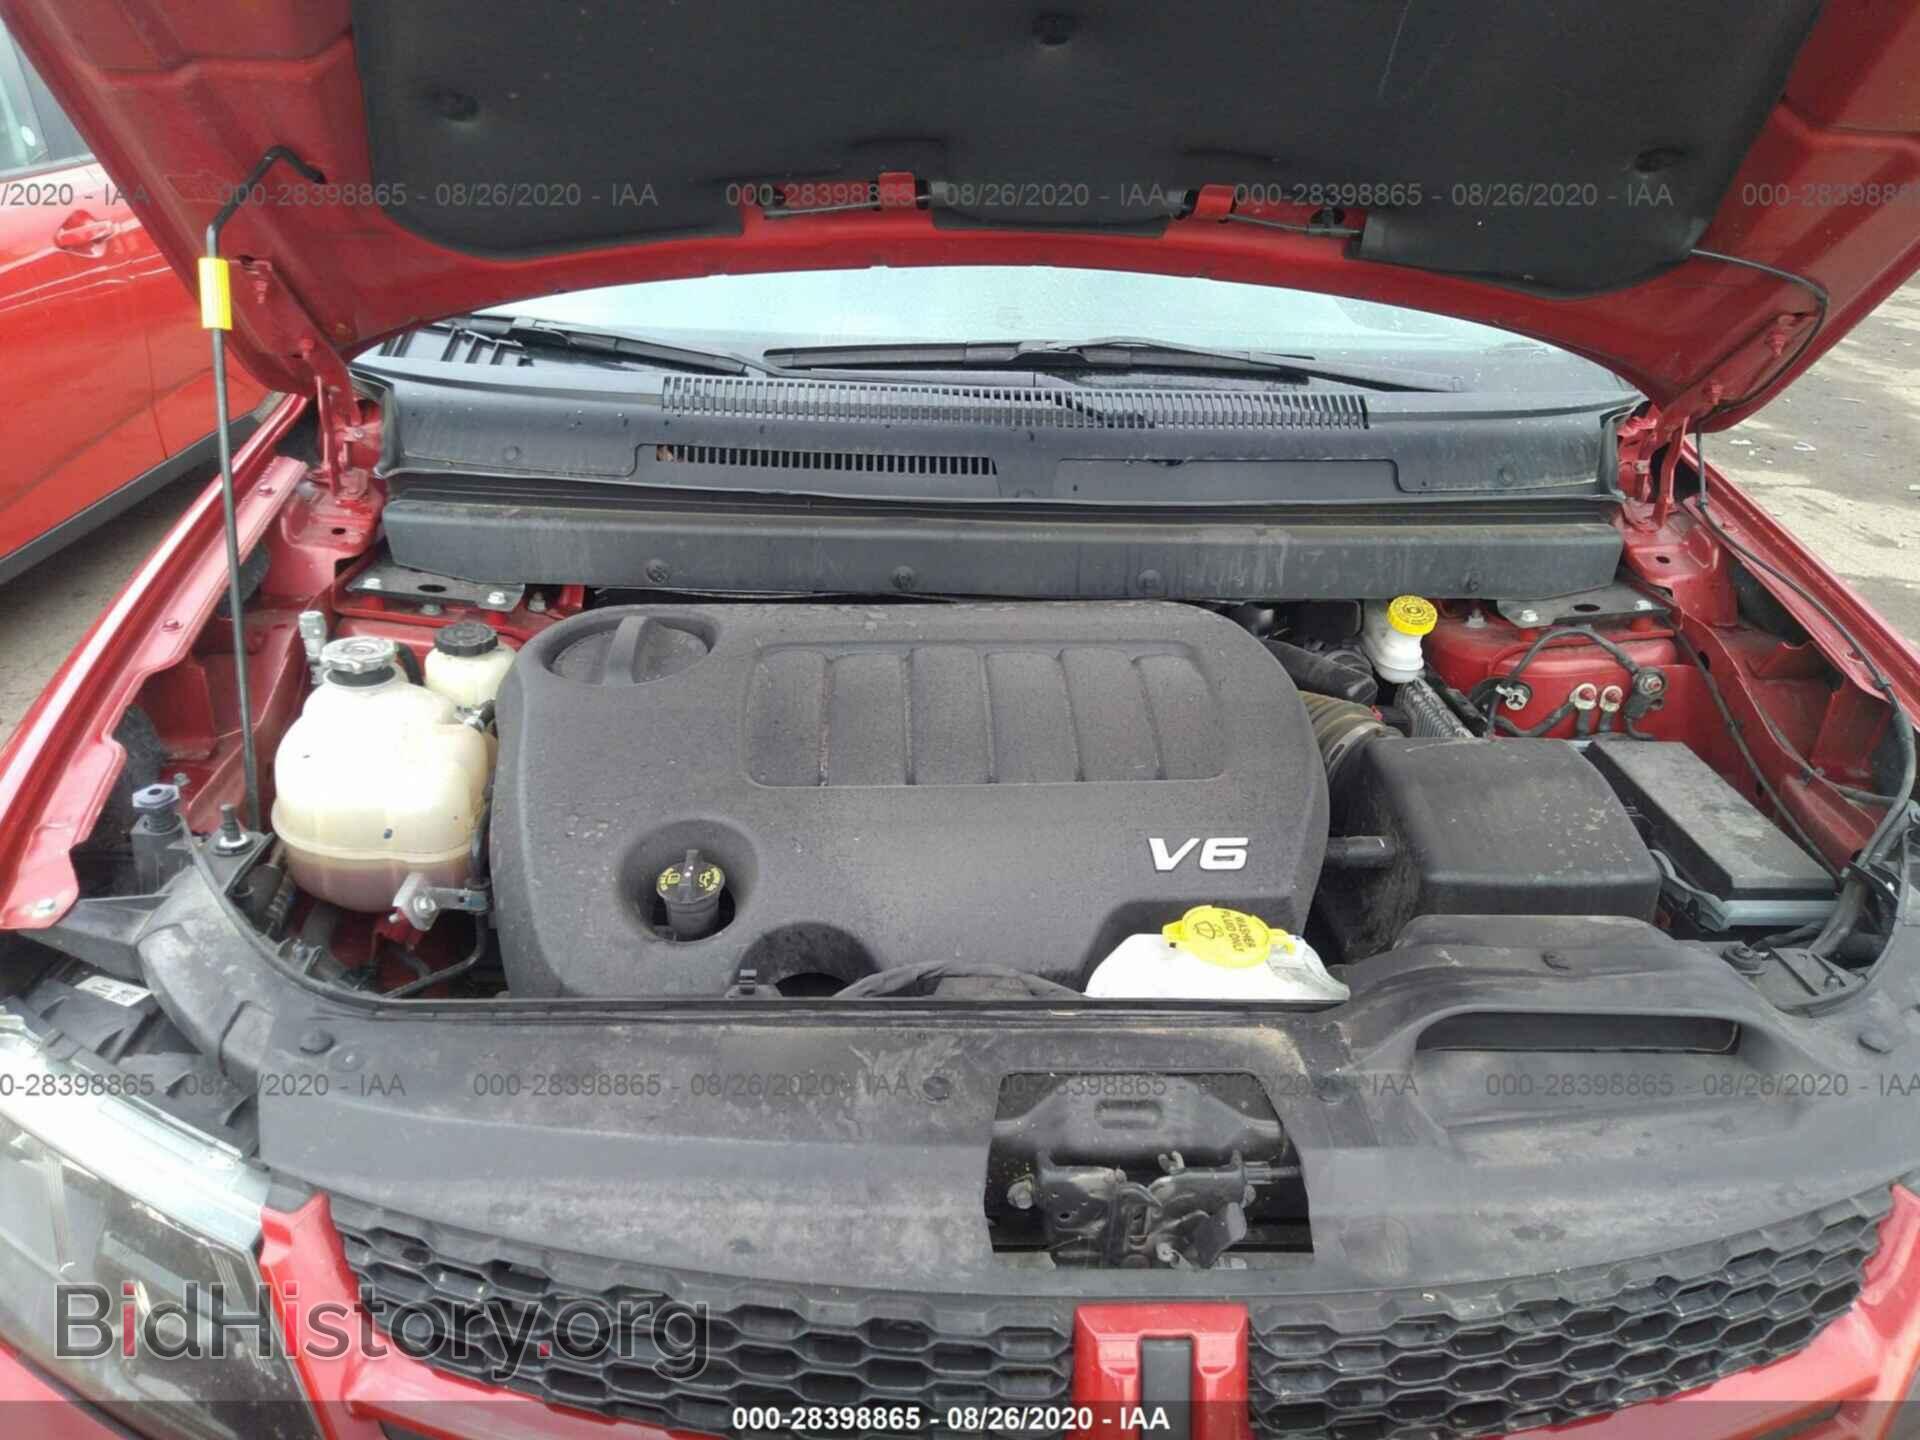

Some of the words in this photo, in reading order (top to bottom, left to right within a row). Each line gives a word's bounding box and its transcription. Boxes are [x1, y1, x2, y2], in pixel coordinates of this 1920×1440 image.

[1148, 837, 1249, 871] V6
[1221, 910, 1237, 932] FLUID
[1229, 932, 1245, 952] ONLY
[1235, 916, 1256, 949] WASHER
